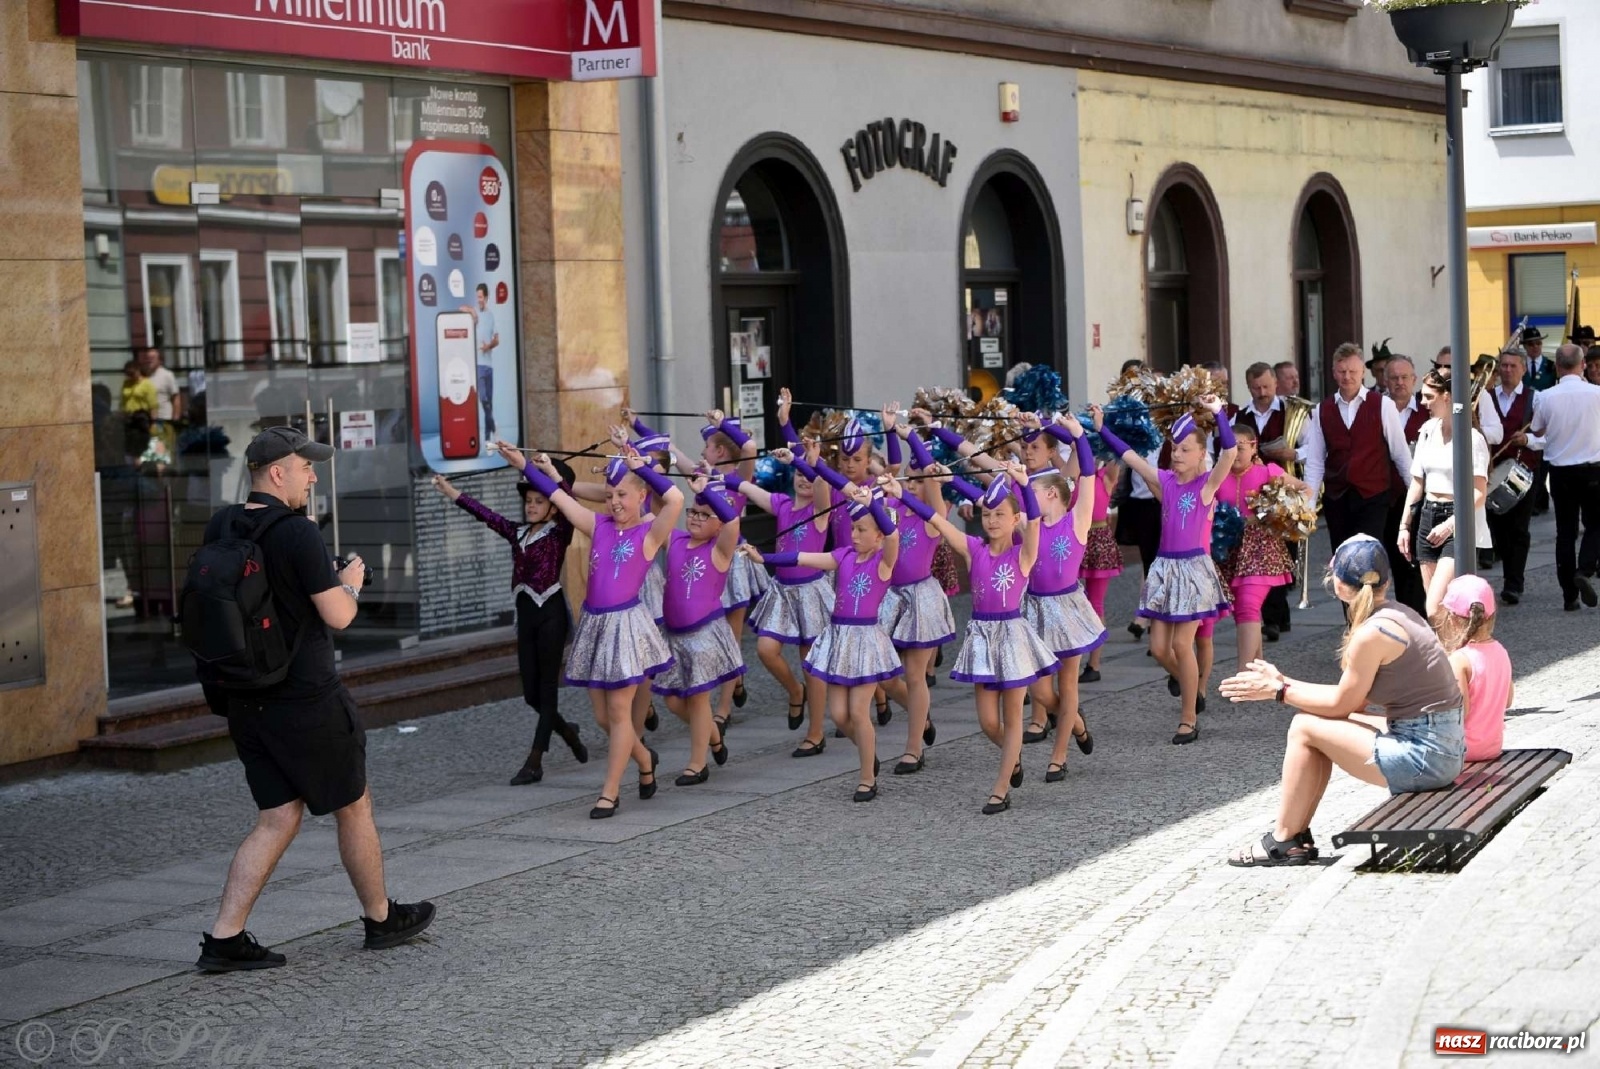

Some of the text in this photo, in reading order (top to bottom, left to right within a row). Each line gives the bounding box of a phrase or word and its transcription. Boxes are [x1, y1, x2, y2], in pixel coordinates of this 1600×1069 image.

[582, 0, 629, 46] M
[391, 34, 431, 61] bank
[578, 57, 631, 73] Partner
[429, 85, 478, 102] Nowe konto
[421, 101, 467, 118] Millennium
[420, 118, 469, 135] inspirowane
[839, 117, 957, 193] FOTOGRAF
[1513, 230, 1573, 242] Bank Pekao
